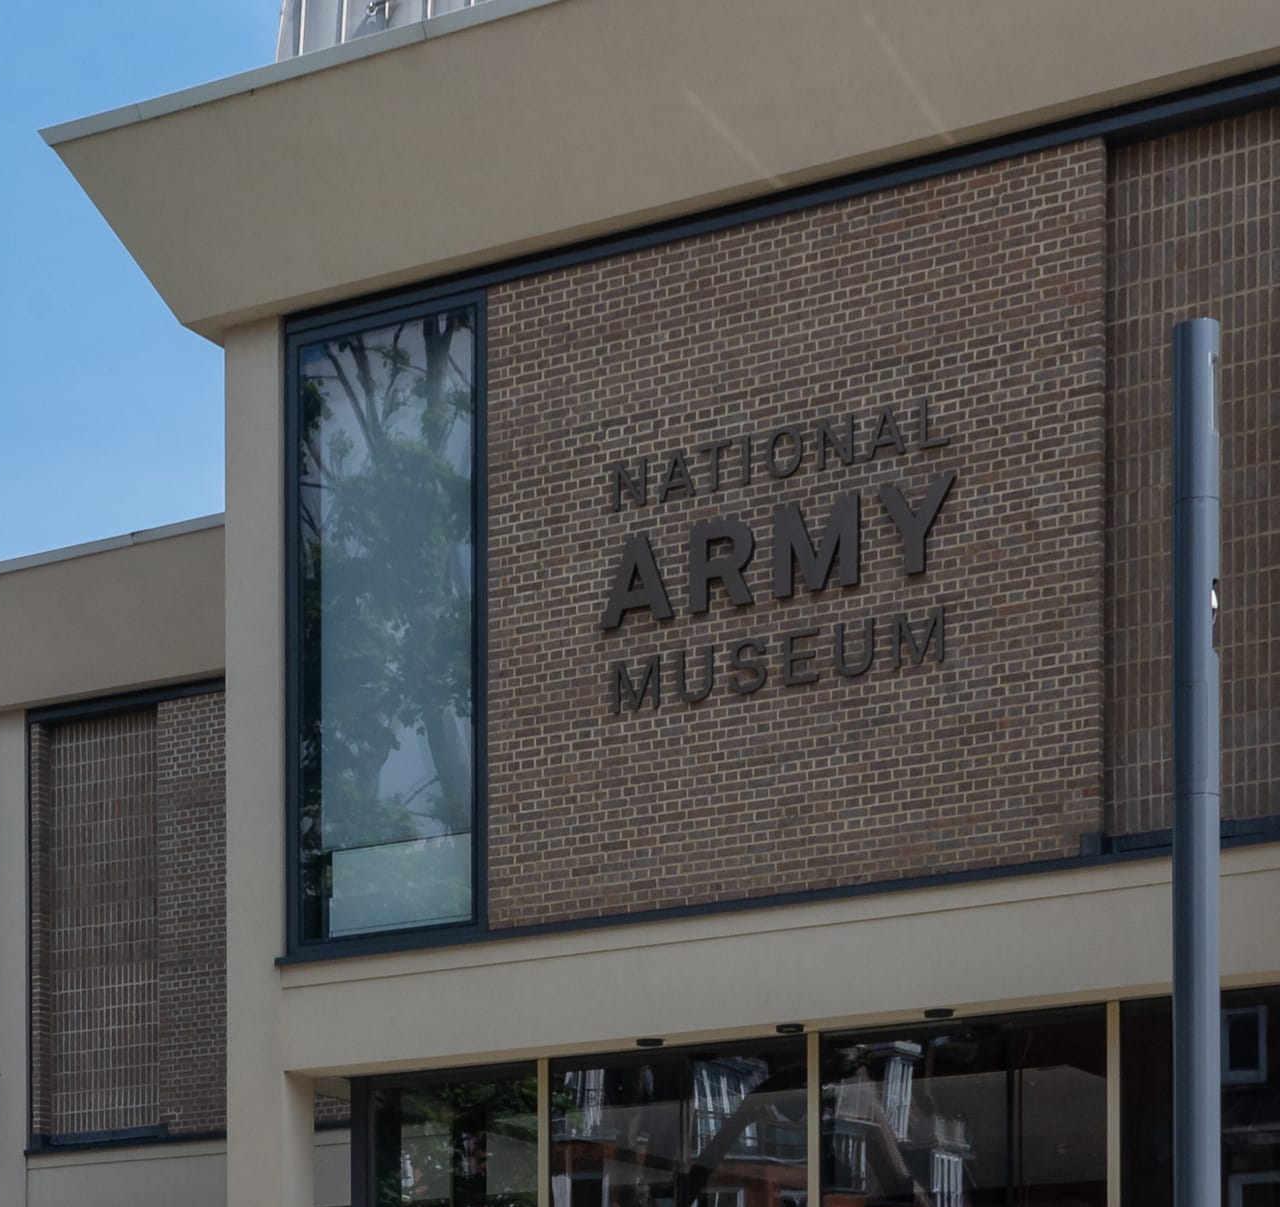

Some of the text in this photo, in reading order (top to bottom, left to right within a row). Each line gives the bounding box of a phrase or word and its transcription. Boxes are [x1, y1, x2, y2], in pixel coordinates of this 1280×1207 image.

[611, 399, 951, 513] NATIONAL
[601, 471, 957, 632] ARMY
[612, 605, 946, 715] MUSEUM
